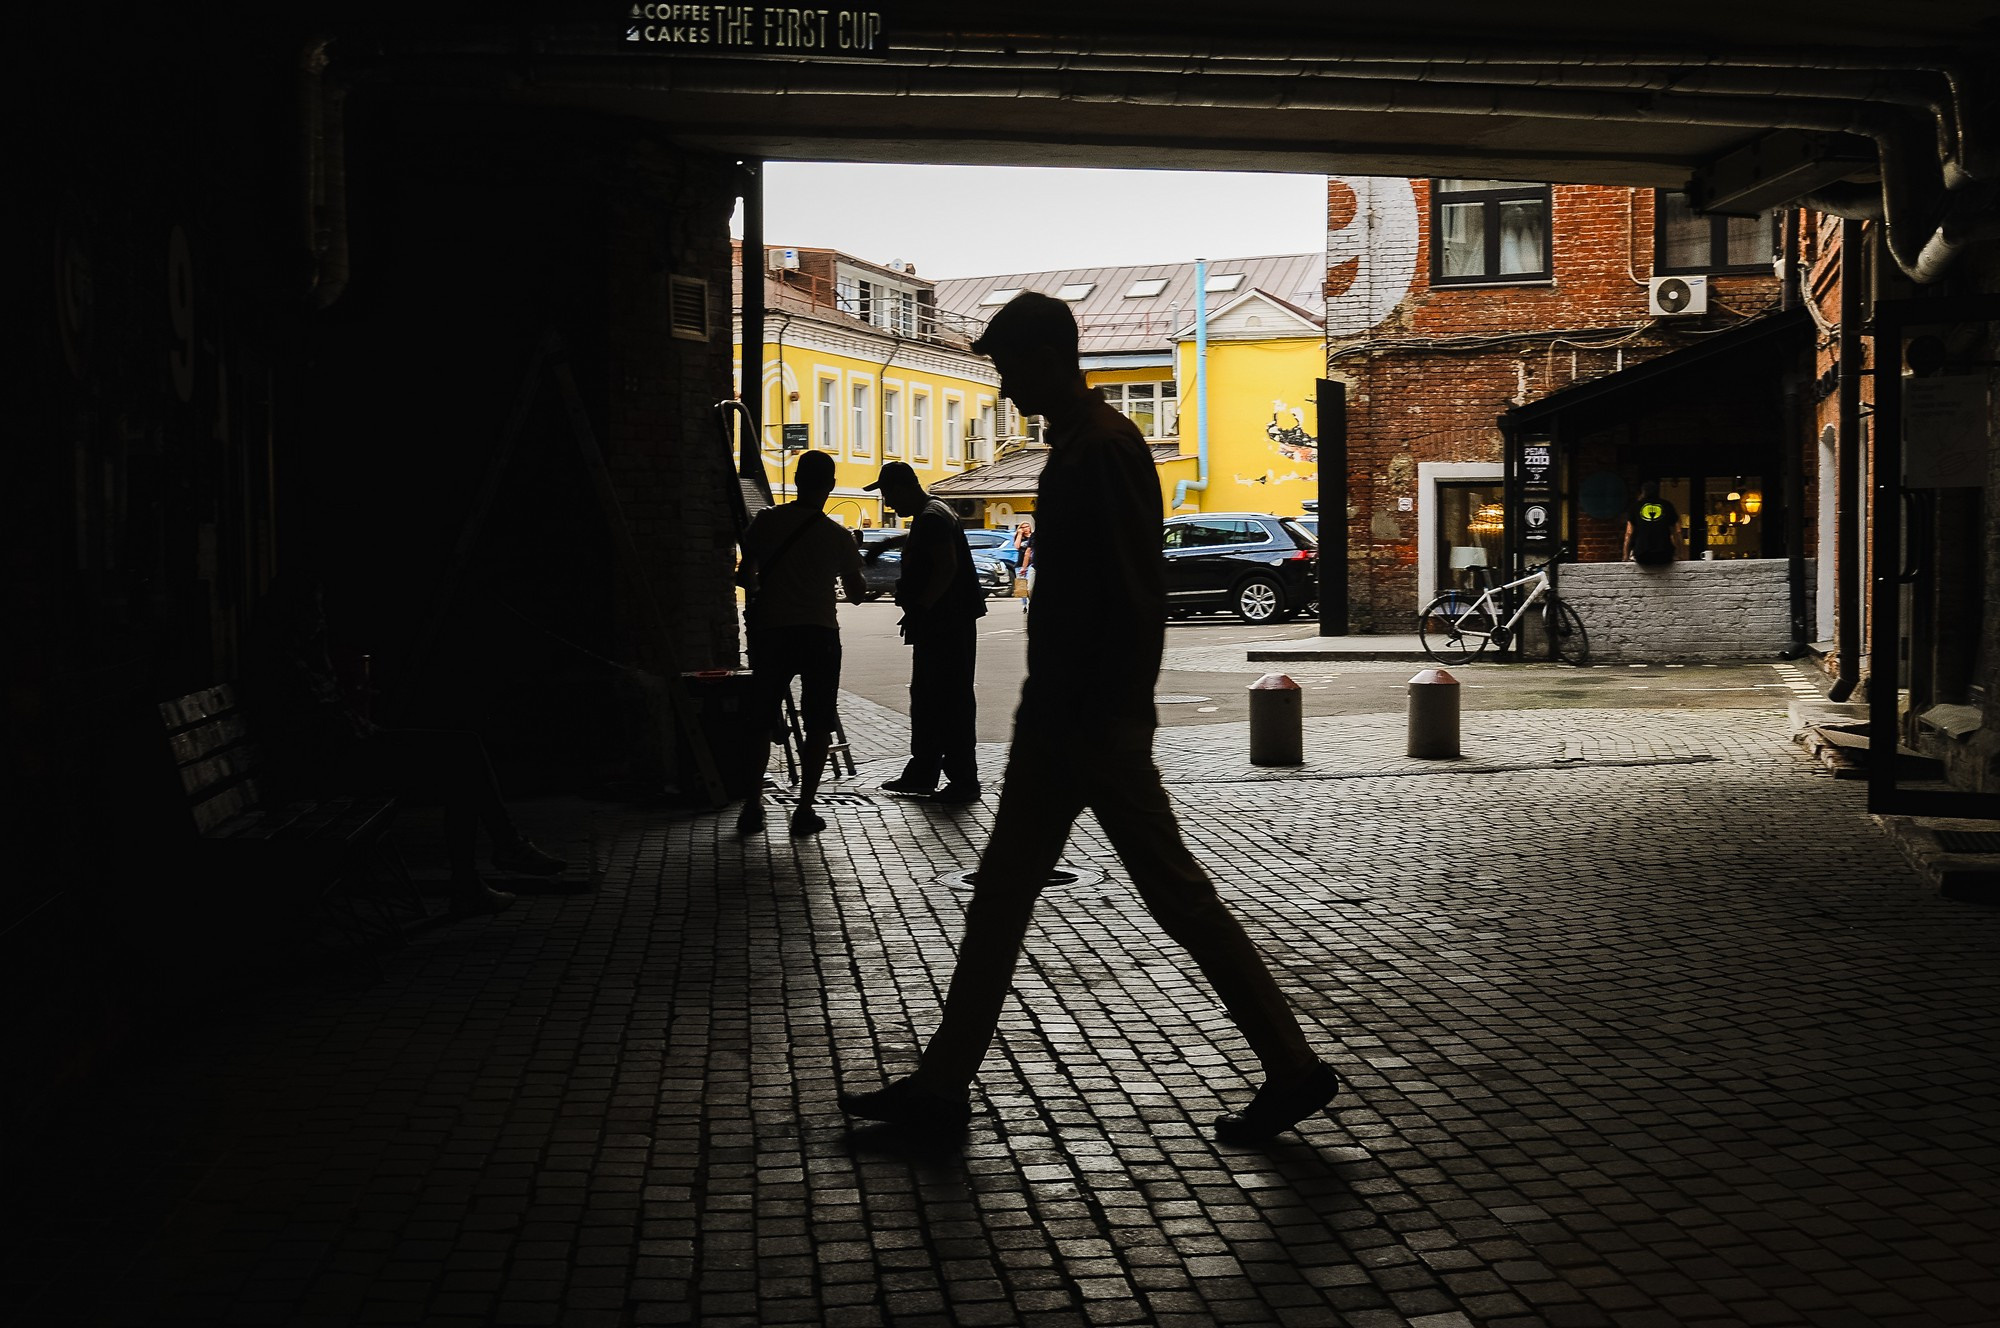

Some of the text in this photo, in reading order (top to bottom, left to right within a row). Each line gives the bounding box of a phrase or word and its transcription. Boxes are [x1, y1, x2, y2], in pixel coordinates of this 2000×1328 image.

[644, 3, 711, 22] COFFEE
[644, 25, 711, 44] CAKES
[713, 5, 881, 51] THE FIRST CUP
